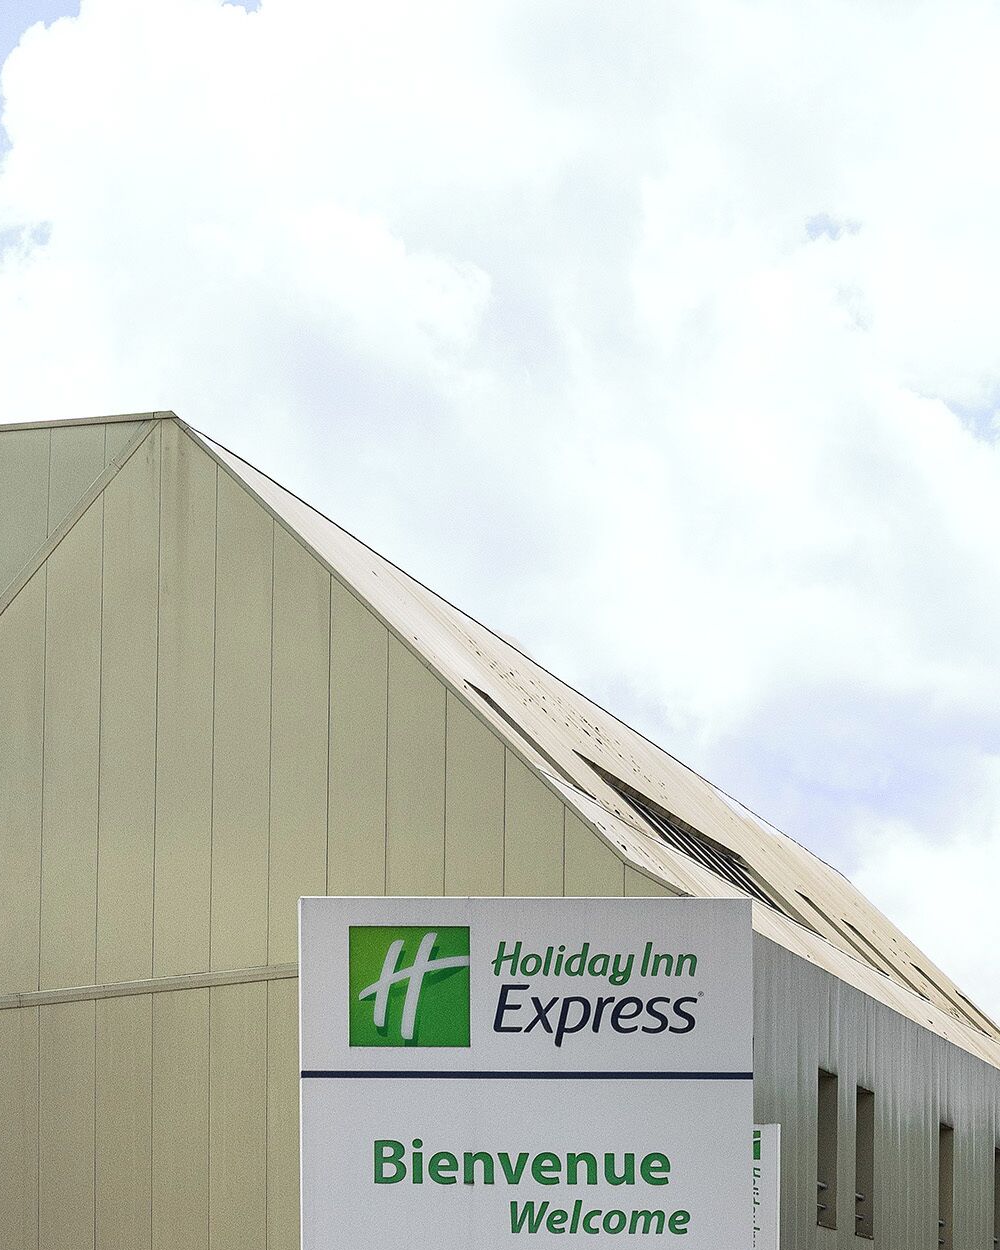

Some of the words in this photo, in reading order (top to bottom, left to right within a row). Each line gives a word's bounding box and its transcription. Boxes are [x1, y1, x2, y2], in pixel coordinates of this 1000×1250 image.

[491, 941, 635, 986] Holiday
[640, 941, 698, 977] Inn
[493, 984, 698, 1048] Express
[373, 1138, 671, 1186] Bienvenue
[510, 1199, 691, 1235] Welcome
